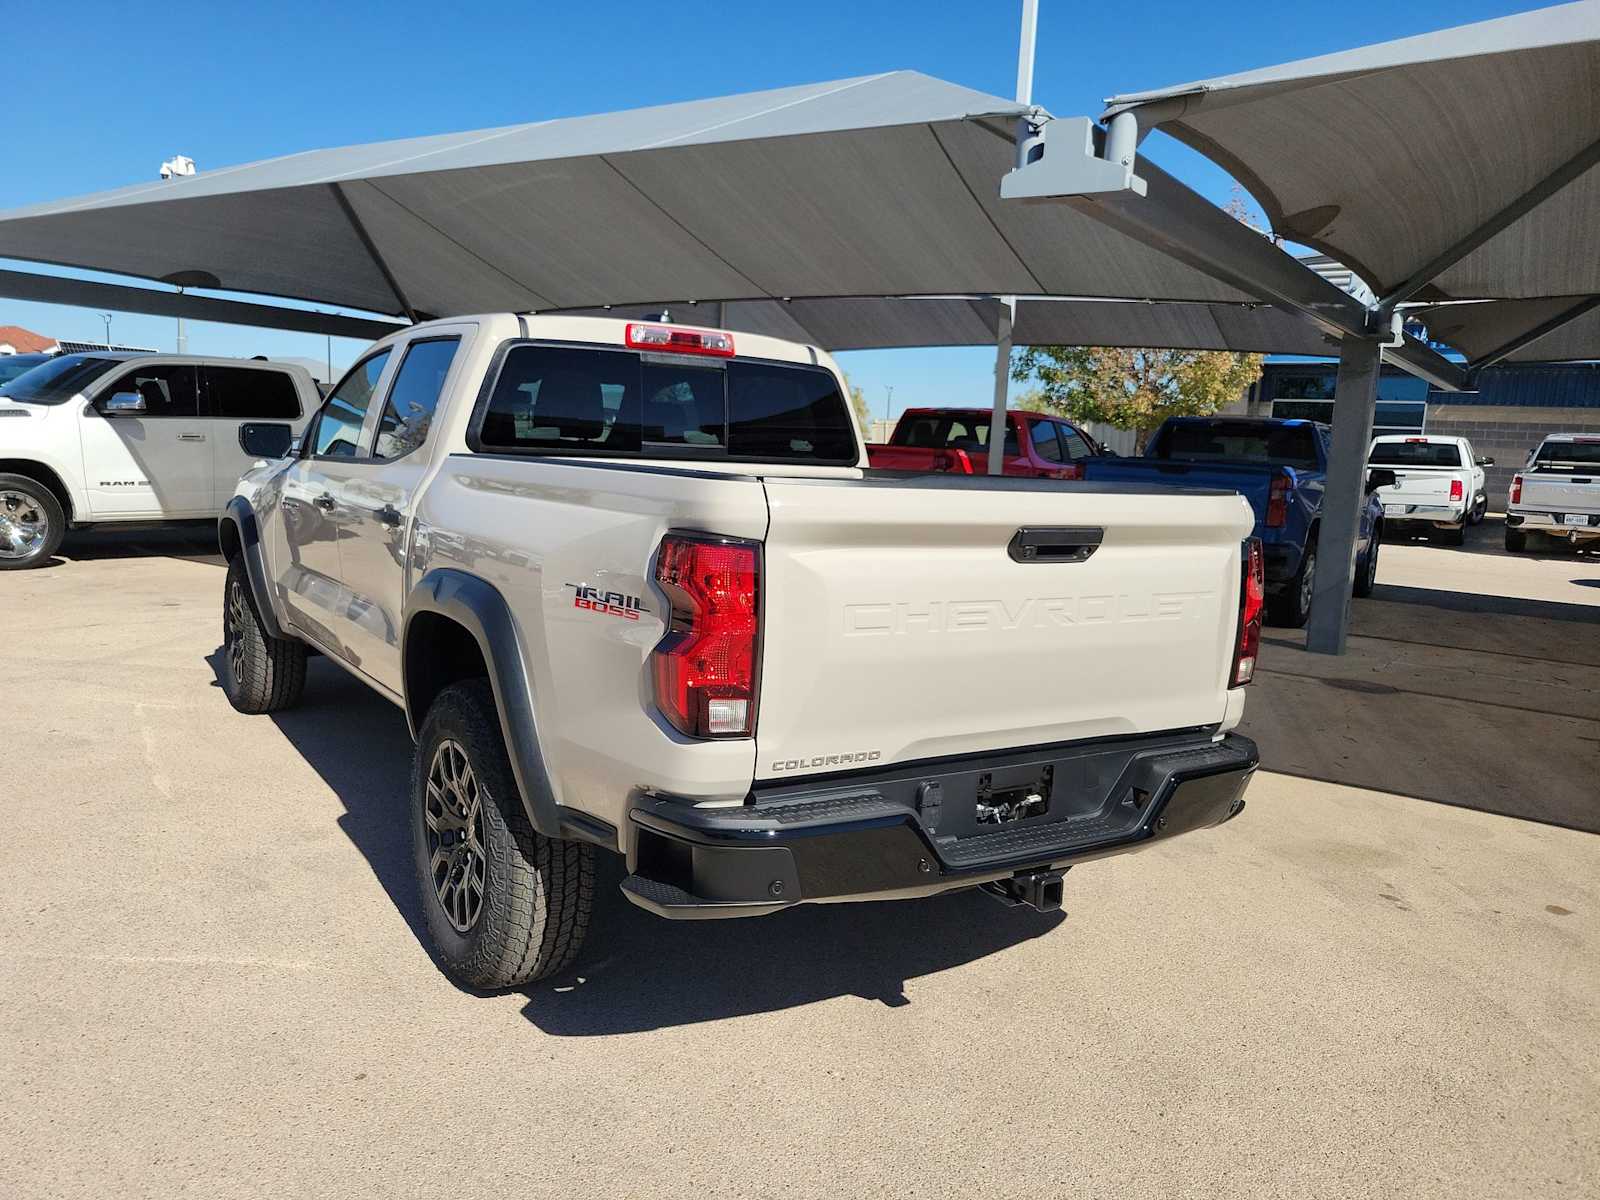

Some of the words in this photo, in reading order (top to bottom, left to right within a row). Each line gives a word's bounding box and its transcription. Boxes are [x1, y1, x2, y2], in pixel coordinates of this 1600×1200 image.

[565, 583, 650, 612] TRAIL
[575, 597, 640, 620] BOSS
[843, 590, 1216, 638] CHEVROLET
[772, 750, 881, 771] COLORADO
